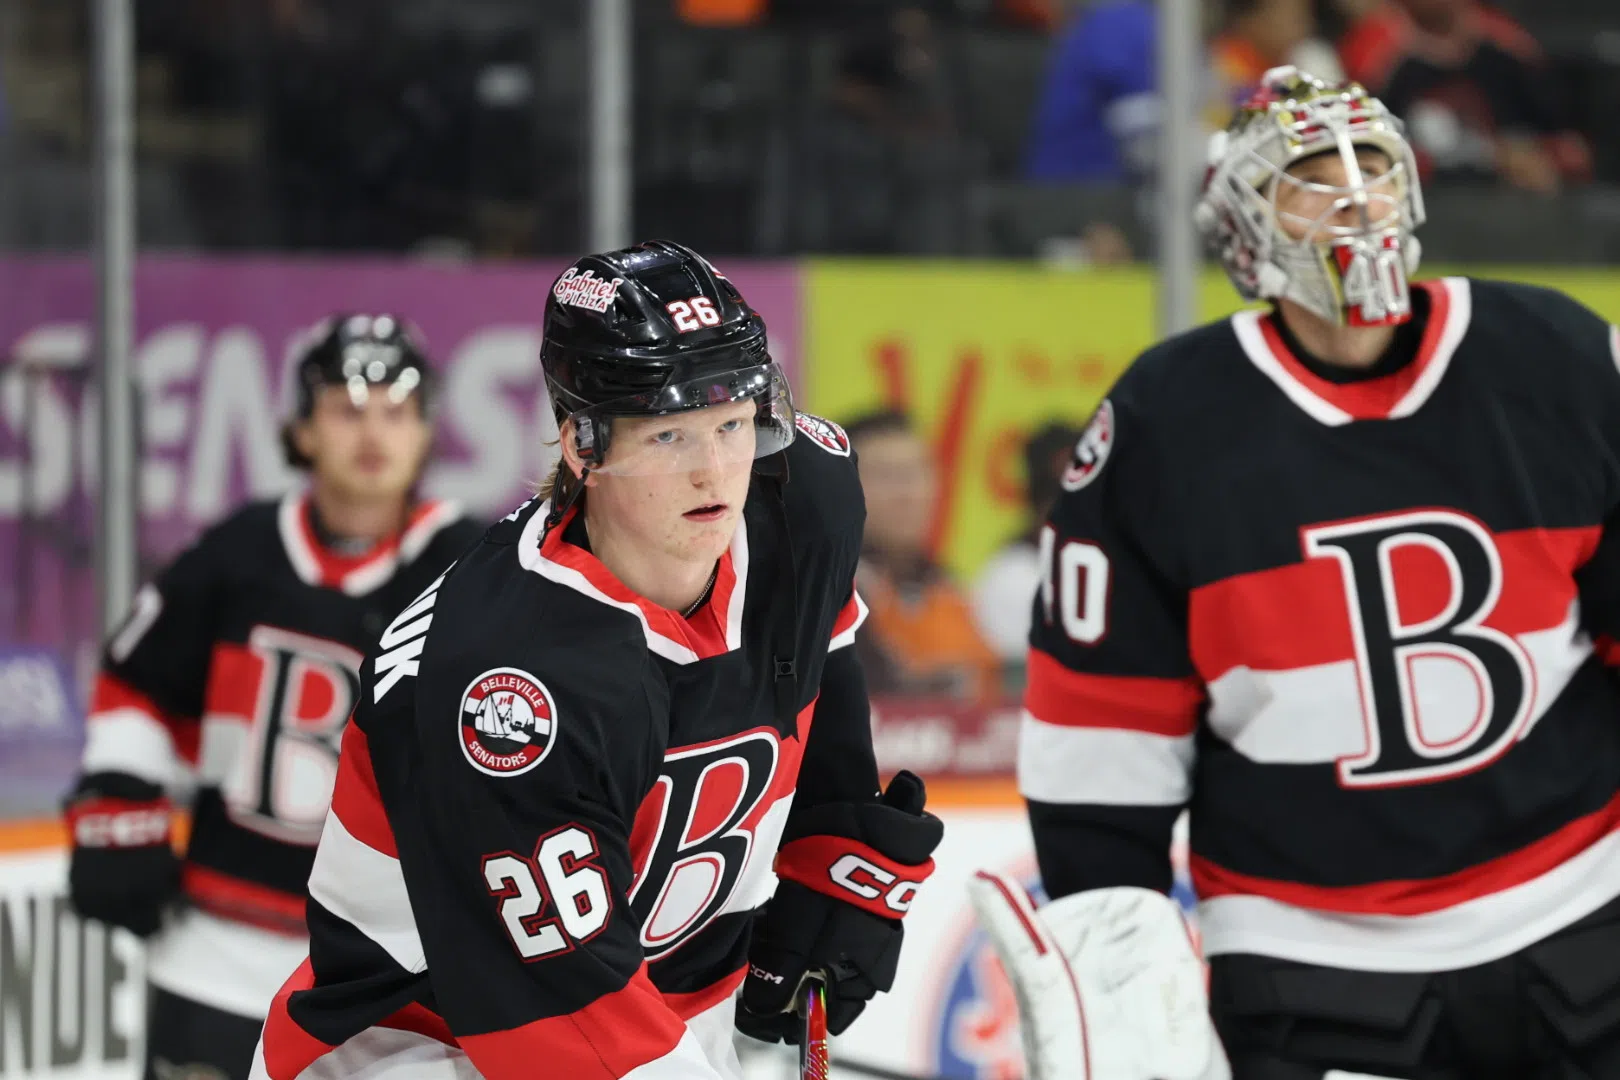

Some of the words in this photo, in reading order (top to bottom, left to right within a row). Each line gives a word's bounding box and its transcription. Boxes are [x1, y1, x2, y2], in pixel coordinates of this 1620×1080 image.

[554, 268, 622, 301] Gabriel
[562, 292, 606, 312] PIZZA
[666, 296, 722, 333] 26
[1300, 507, 1537, 788] B
[480, 675, 545, 709] BELLEVILLE
[226, 625, 363, 846] B
[468, 740, 528, 768] SENATORS
[627, 726, 779, 963] B
[480, 822, 613, 963] 26
